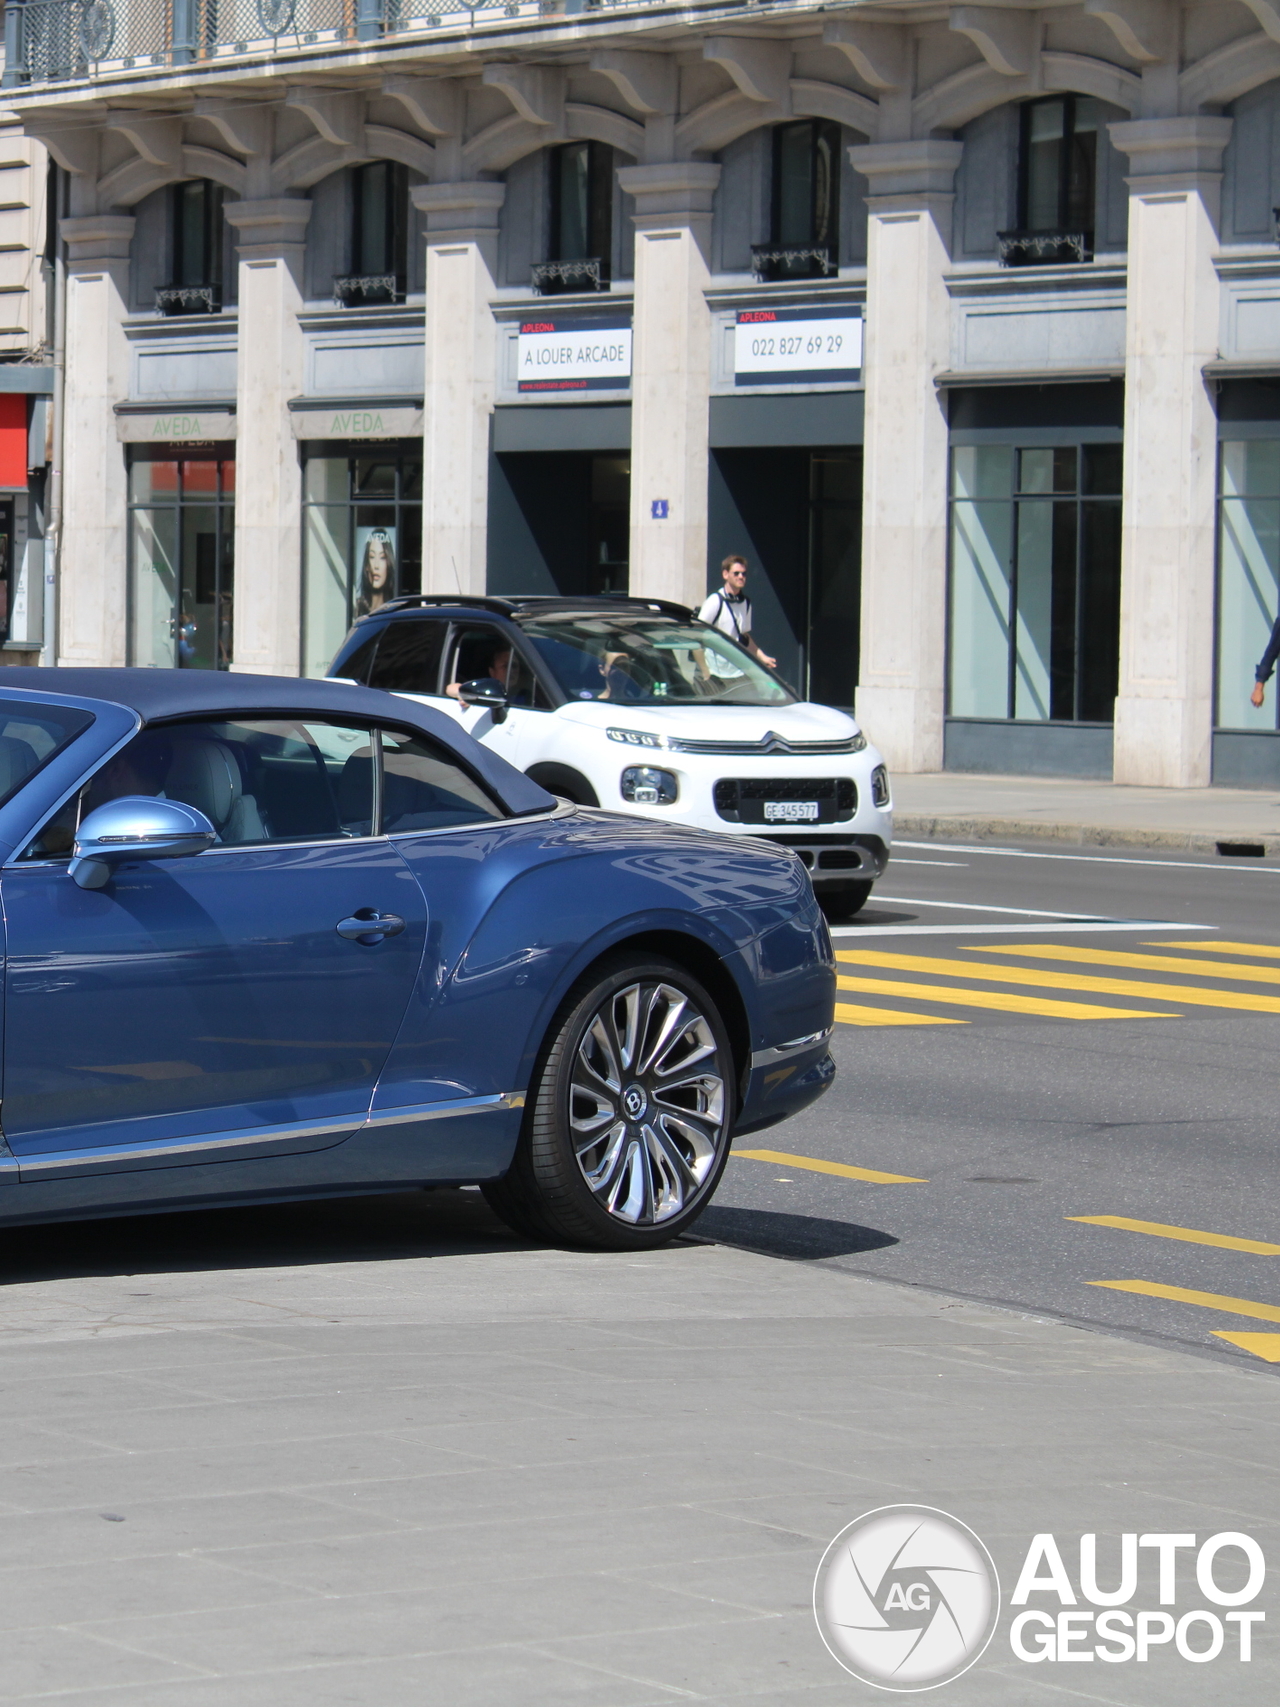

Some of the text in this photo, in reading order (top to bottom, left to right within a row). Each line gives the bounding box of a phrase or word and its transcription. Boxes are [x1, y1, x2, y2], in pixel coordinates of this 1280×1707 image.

[740, 312, 776, 322] APLEONA
[522, 323, 555, 333] APLEONA
[752, 335, 842, 356] 022 827 69 29
[525, 345, 624, 365] A LOUER ARCADE
[152, 417, 201, 436] AVEDA
[331, 413, 384, 433] AVEDA
[656, 501, 663, 516] 4
[366, 532, 391, 543] AVEDA
